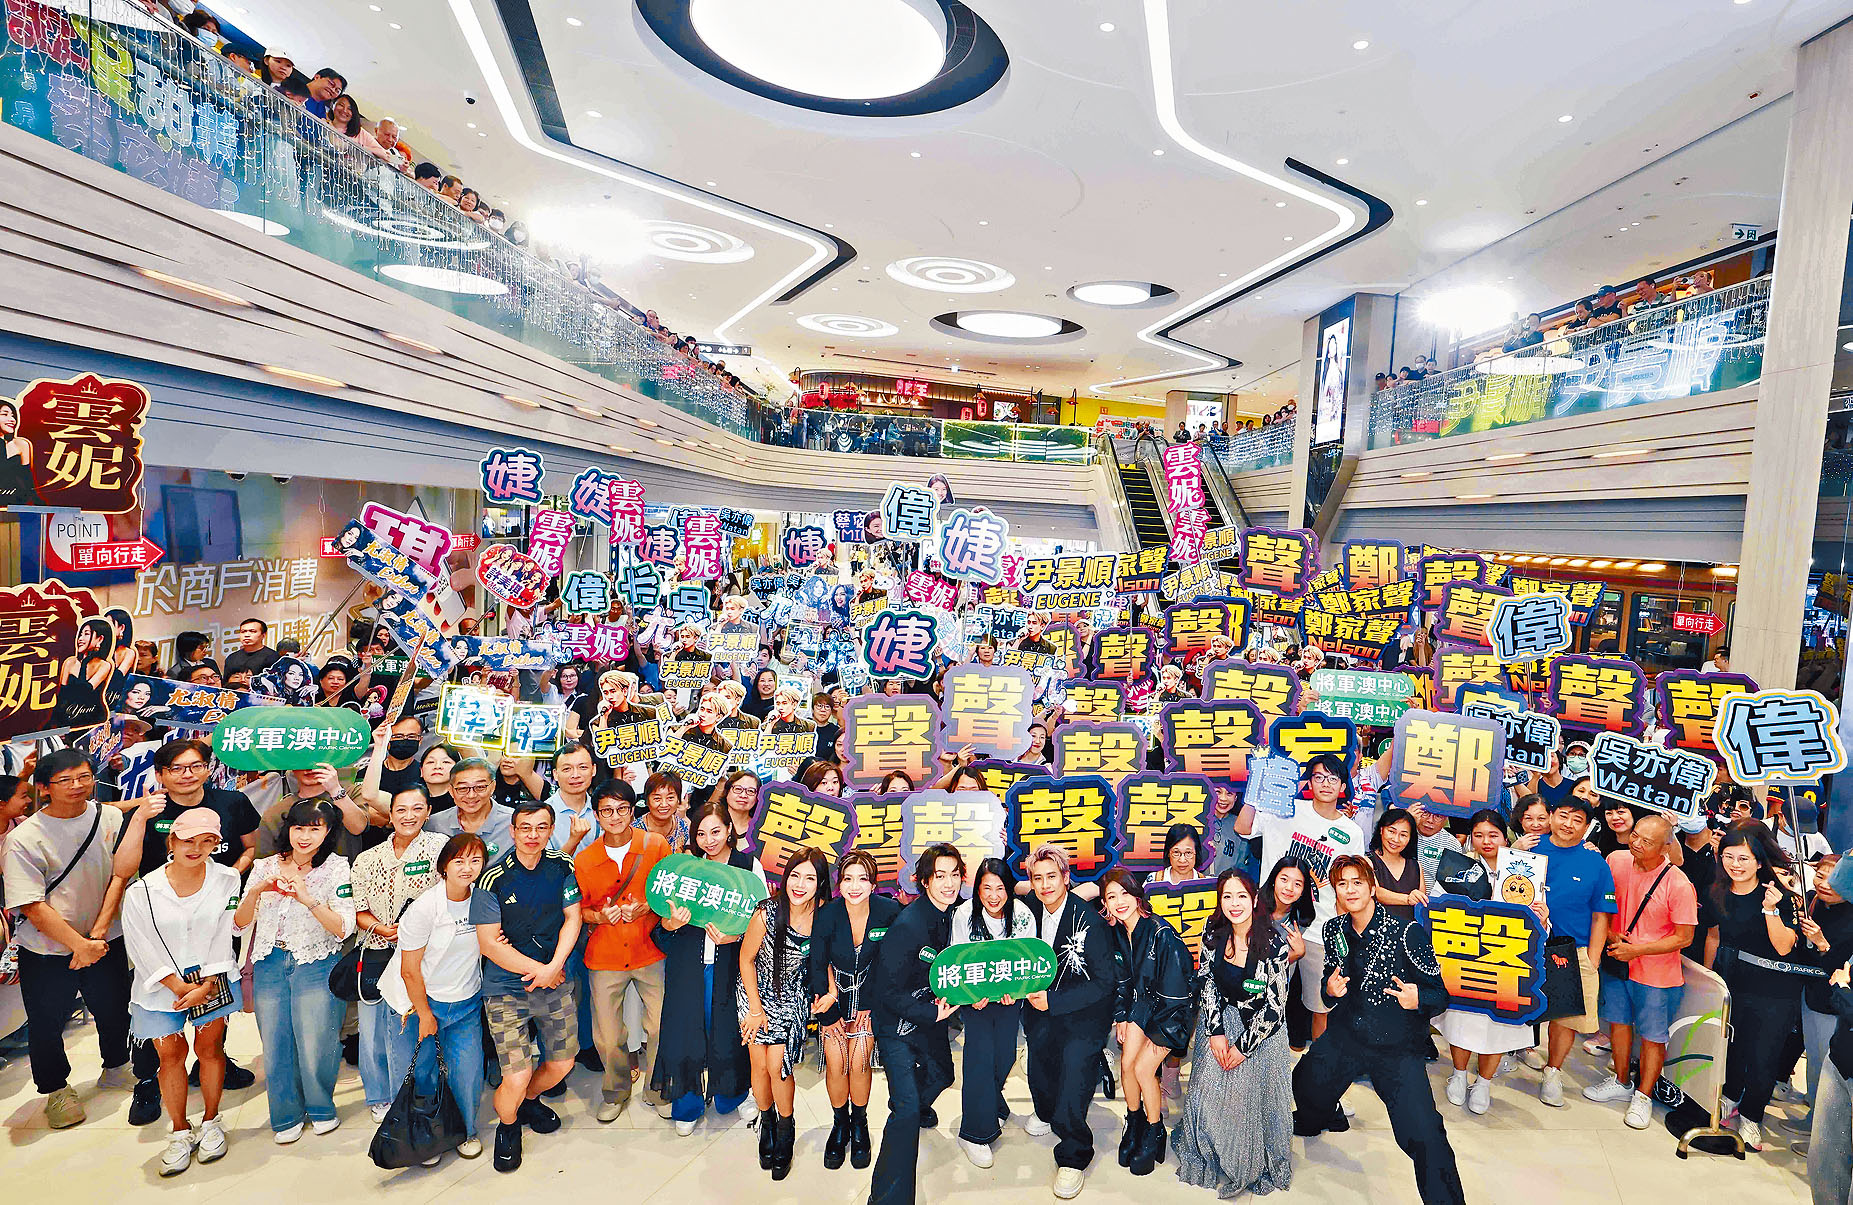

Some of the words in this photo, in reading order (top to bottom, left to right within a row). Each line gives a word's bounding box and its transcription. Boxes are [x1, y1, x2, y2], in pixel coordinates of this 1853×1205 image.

[41, 391, 126, 492] 雲妮
[486, 453, 538, 499] 婕
[1166, 443, 1204, 512] 雲妮
[610, 480, 646, 545] 雲妮
[886, 486, 932, 535] 偉
[57, 523, 101, 539] POINT
[529, 510, 575, 575] 雲妮
[686, 516, 722, 579] 雲妮
[944, 515, 999, 579] 婕
[78, 547, 147, 566] 單向行走
[363, 540, 410, 572] 尤淑情
[1024, 555, 1116, 592] 尹景順
[1245, 534, 1305, 593] 聲
[1348, 545, 1398, 590] 鄭
[133, 558, 318, 616] 於商戶消費
[566, 575, 607, 611] 偉
[906, 572, 956, 612] 雲妮
[1035, 592, 1101, 610] EUGENE
[1318, 581, 1416, 614] 鄭家聲
[709, 634, 757, 650] 尹景順
[1304, 609, 1400, 644] 鄭家聲
[1497, 600, 1562, 657] 偉
[1676, 615, 1715, 631] 單向行走
[0, 605, 59, 711] 雲妮
[479, 641, 523, 655] 尤淑情
[503, 653, 544, 666] Esther
[562, 625, 627, 661] 雲妮
[715, 653, 750, 661] EUGENE
[870, 615, 931, 675] 婕
[1098, 634, 1149, 679] 聲
[1307, 635, 1382, 660] Nelson
[662, 662, 710, 678] 尹景順
[667, 680, 702, 688] EUGENE
[1315, 673, 1409, 695] 將軍澳中心
[106, 690, 121, 705] Yu
[167, 688, 240, 710] 尤淑情
[948, 674, 1025, 752] 聲
[1557, 663, 1637, 732] 聲
[221, 727, 363, 752] 將軍澳中心
[595, 720, 661, 754] 尹景順
[610, 747, 657, 766] EUGENE
[660, 736, 728, 775] 尹景順
[759, 734, 815, 756] 尹景順
[854, 704, 932, 781] 聲
[1171, 710, 1256, 782] 聲
[1506, 747, 1544, 766] tan
[1728, 701, 1832, 775] 偉
[1399, 719, 1494, 808] 鄭
[1597, 739, 1707, 791] 吳亦偉
[1598, 768, 1690, 813] Watan
[1018, 787, 1106, 871] 聲
[651, 869, 757, 913] 將軍澳中心
[938, 956, 1052, 989] 將軍澳中心
[1429, 907, 1533, 1012] 聲
